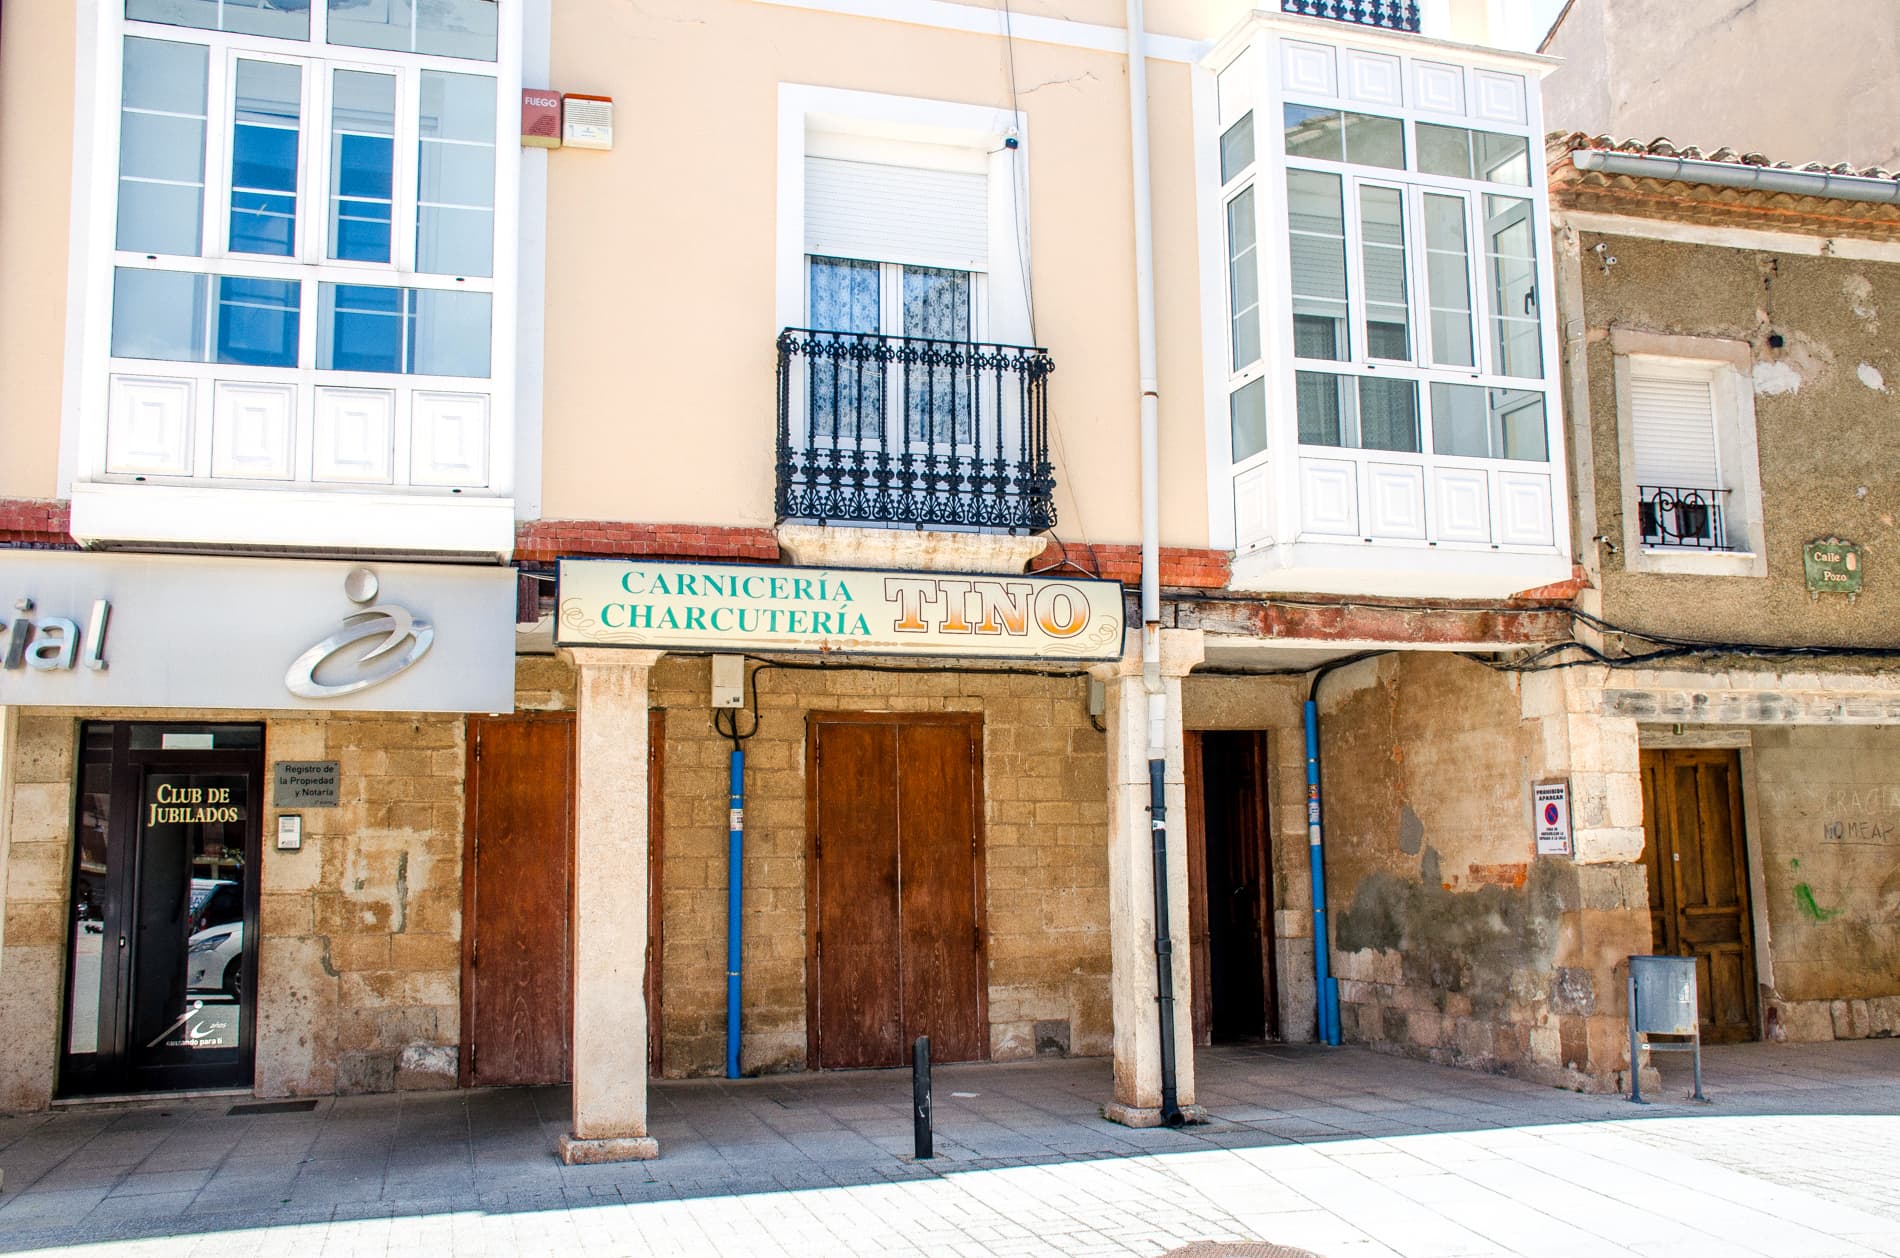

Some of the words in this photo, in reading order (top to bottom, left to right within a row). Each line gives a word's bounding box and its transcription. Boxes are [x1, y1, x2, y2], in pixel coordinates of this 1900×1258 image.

[525, 96, 558, 108] FUEGO
[1814, 551, 1840, 562] Calle
[1823, 571, 1847, 581] Pozo
[621, 571, 855, 601] CARNICERÍA
[884, 578, 1091, 639] TINO
[601, 603, 872, 636] CHARCUTERÍA
[0, 598, 110, 671] ial
[285, 765, 321, 775] Registro
[323, 765, 335, 774] de
[280, 776, 288, 785] la
[290, 776, 334, 786] Propiedad
[157, 784, 202, 804] CLUB
[207, 788, 230, 803] DE
[295, 789, 300, 798] y
[147, 803, 238, 827] JUBILADOS
[199, 1038, 217, 1047] para
